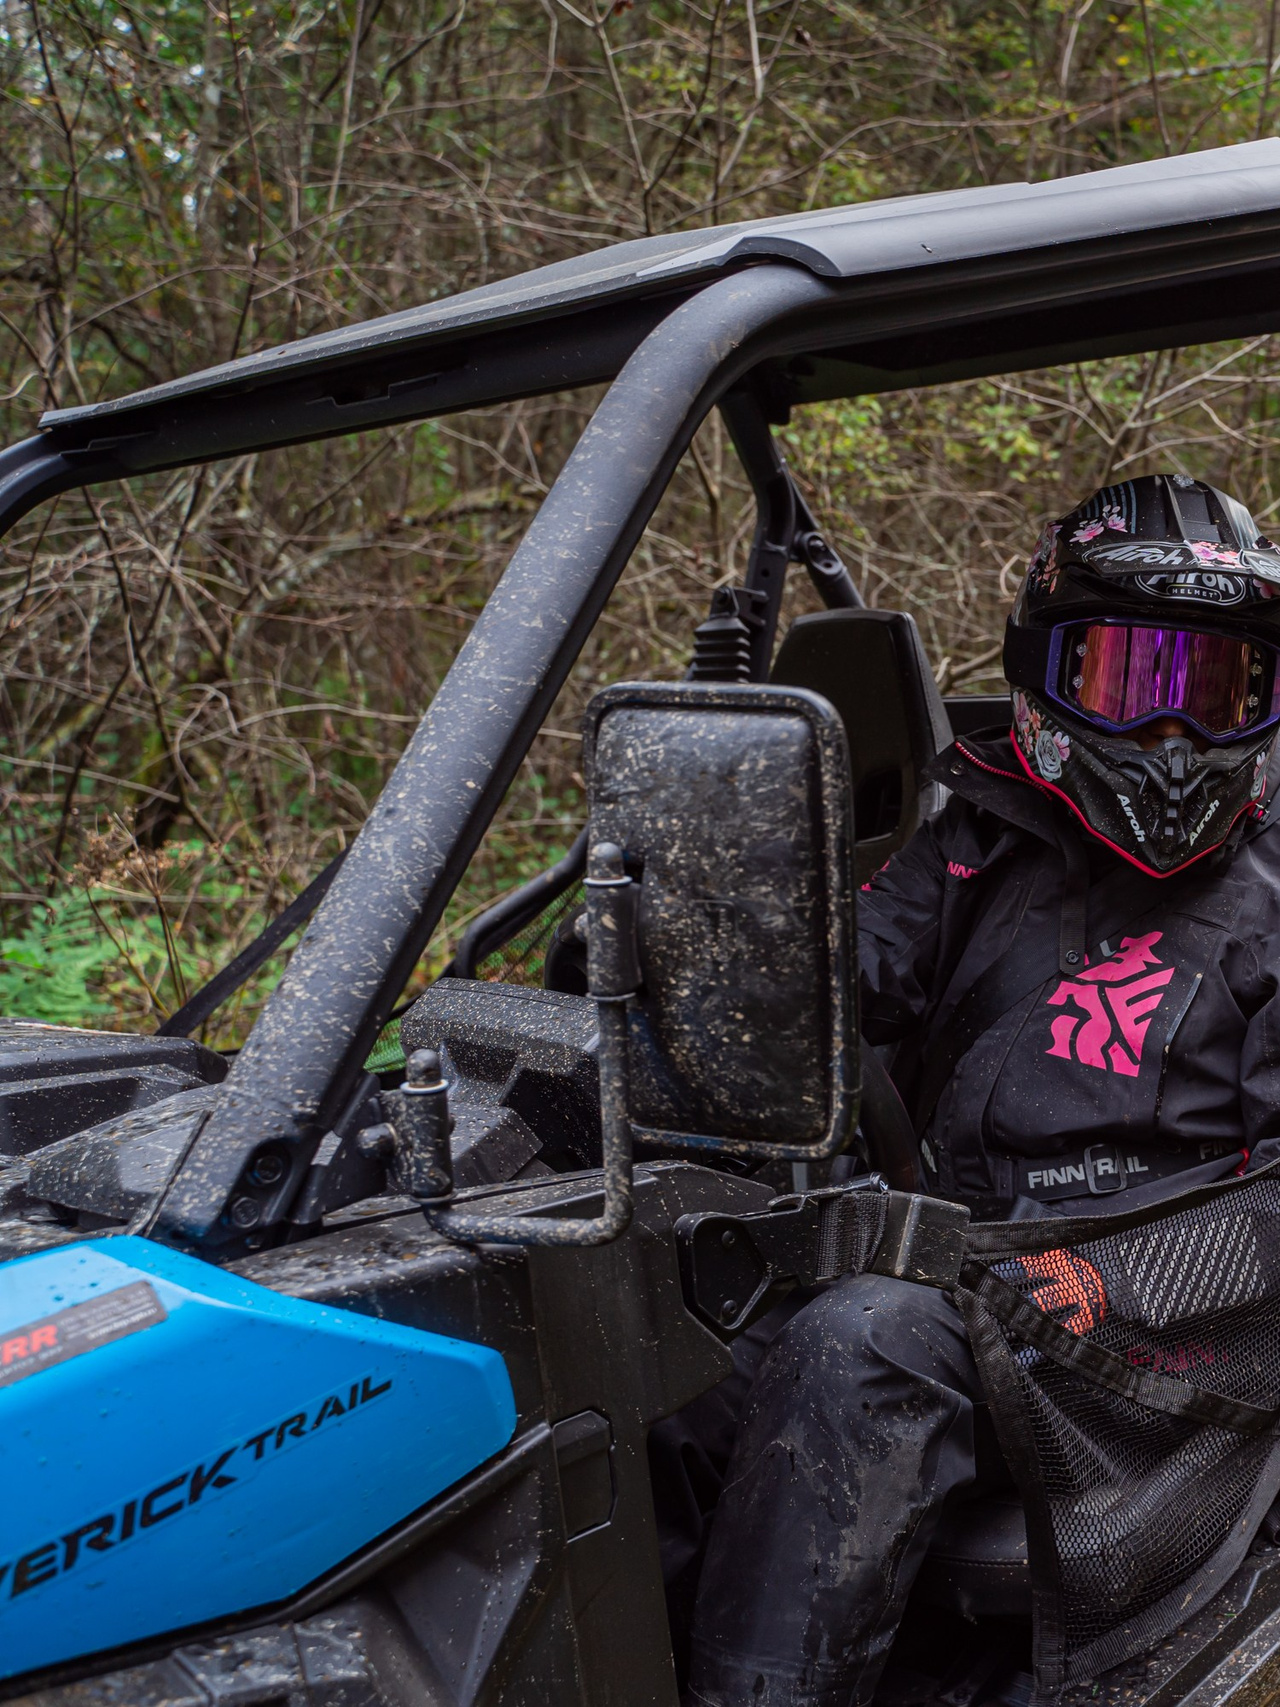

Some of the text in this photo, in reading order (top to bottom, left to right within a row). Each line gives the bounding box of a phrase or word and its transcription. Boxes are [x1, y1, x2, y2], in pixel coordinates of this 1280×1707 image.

[1171, 587, 1216, 599] HELMET
[1116, 793, 1146, 843] Airoh
[1189, 799, 1220, 847] Airoh
[1028, 1156, 1149, 1189] FINNRAIL
[243, 1375, 393, 1461] TRAIL
